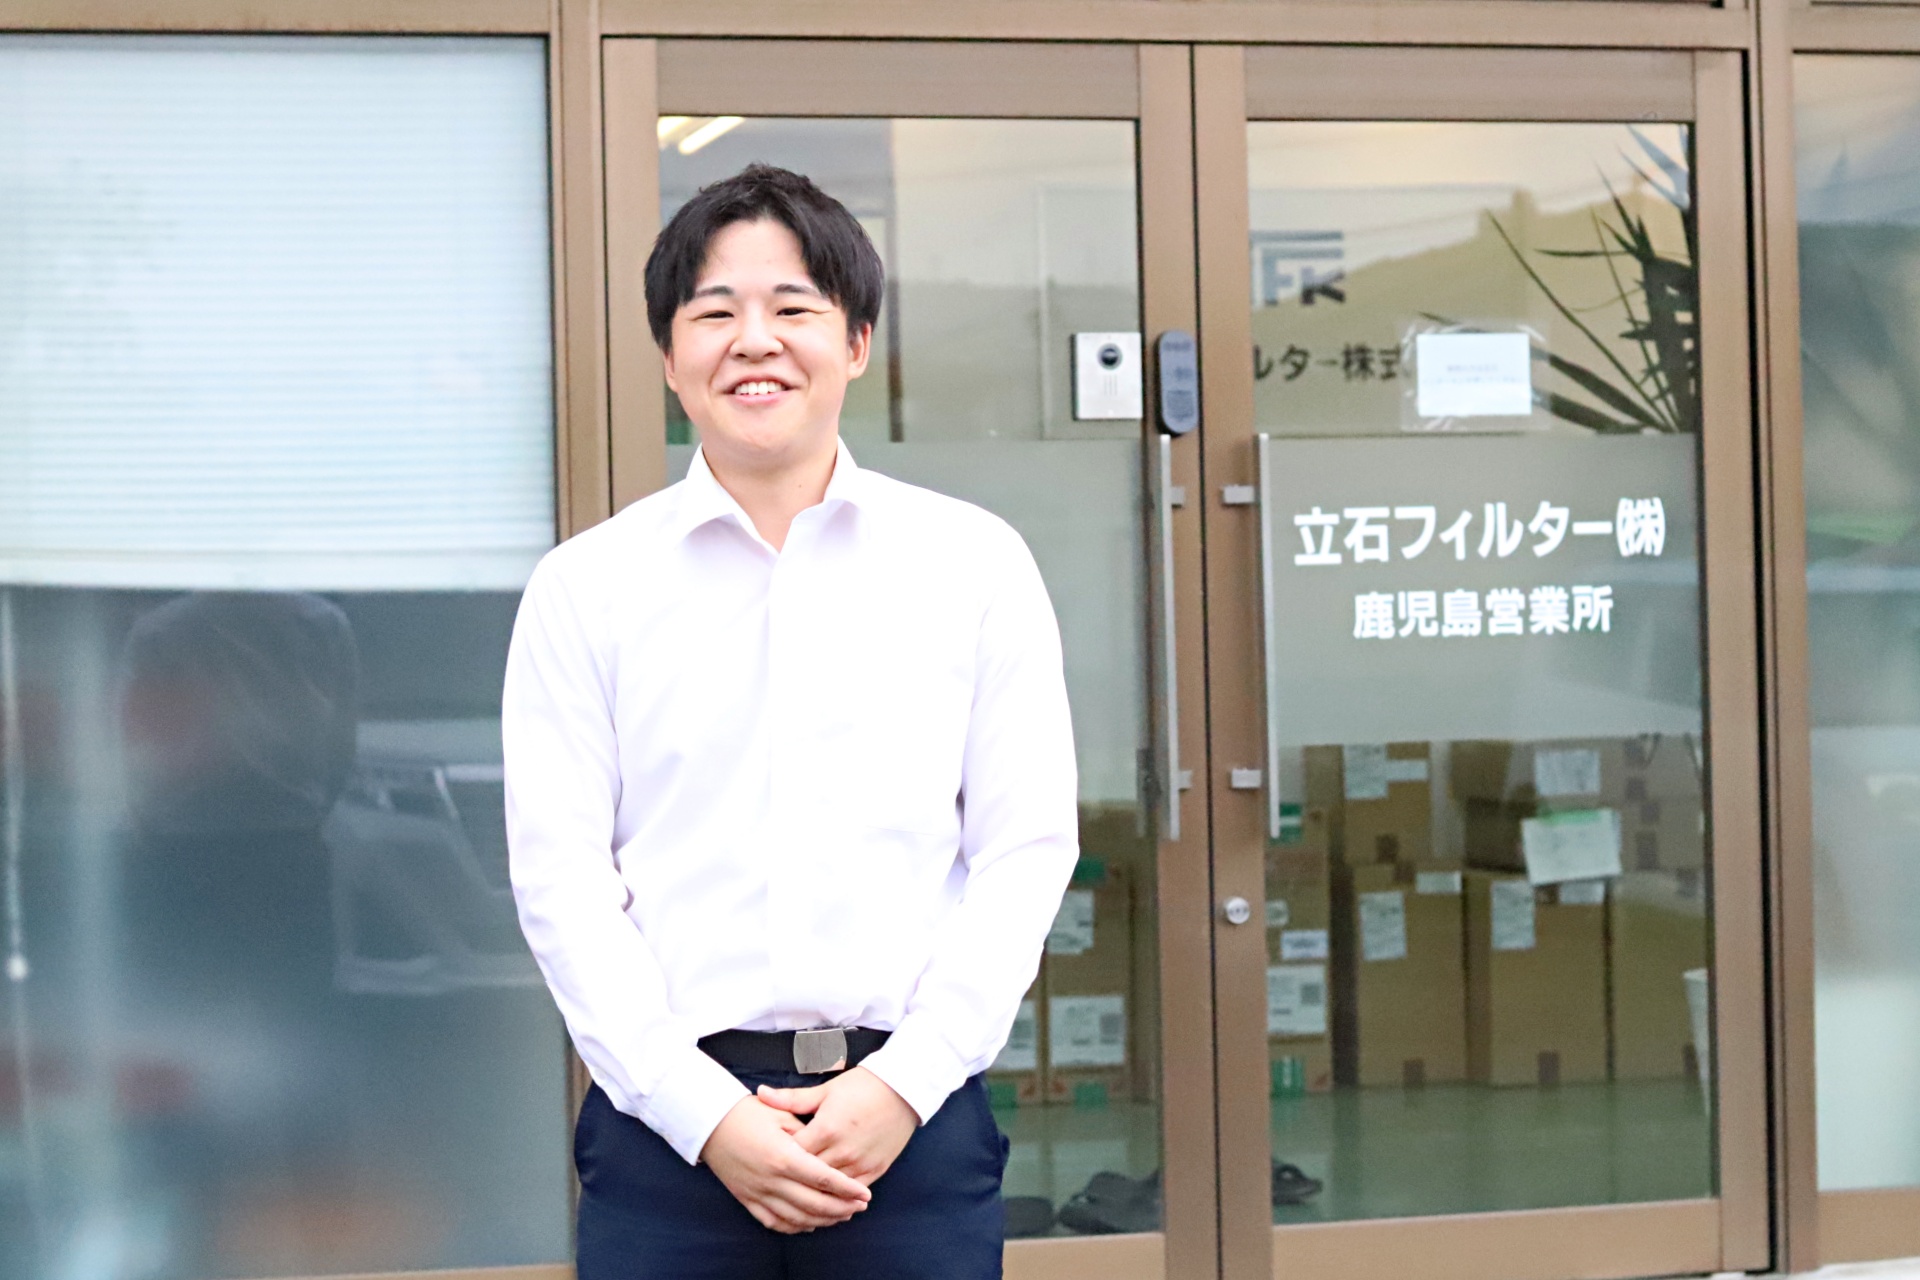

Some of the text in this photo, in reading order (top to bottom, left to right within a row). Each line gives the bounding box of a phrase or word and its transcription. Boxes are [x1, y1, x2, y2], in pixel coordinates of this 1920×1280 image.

[1353, 585, 1614, 639] 鹿児島営業所
